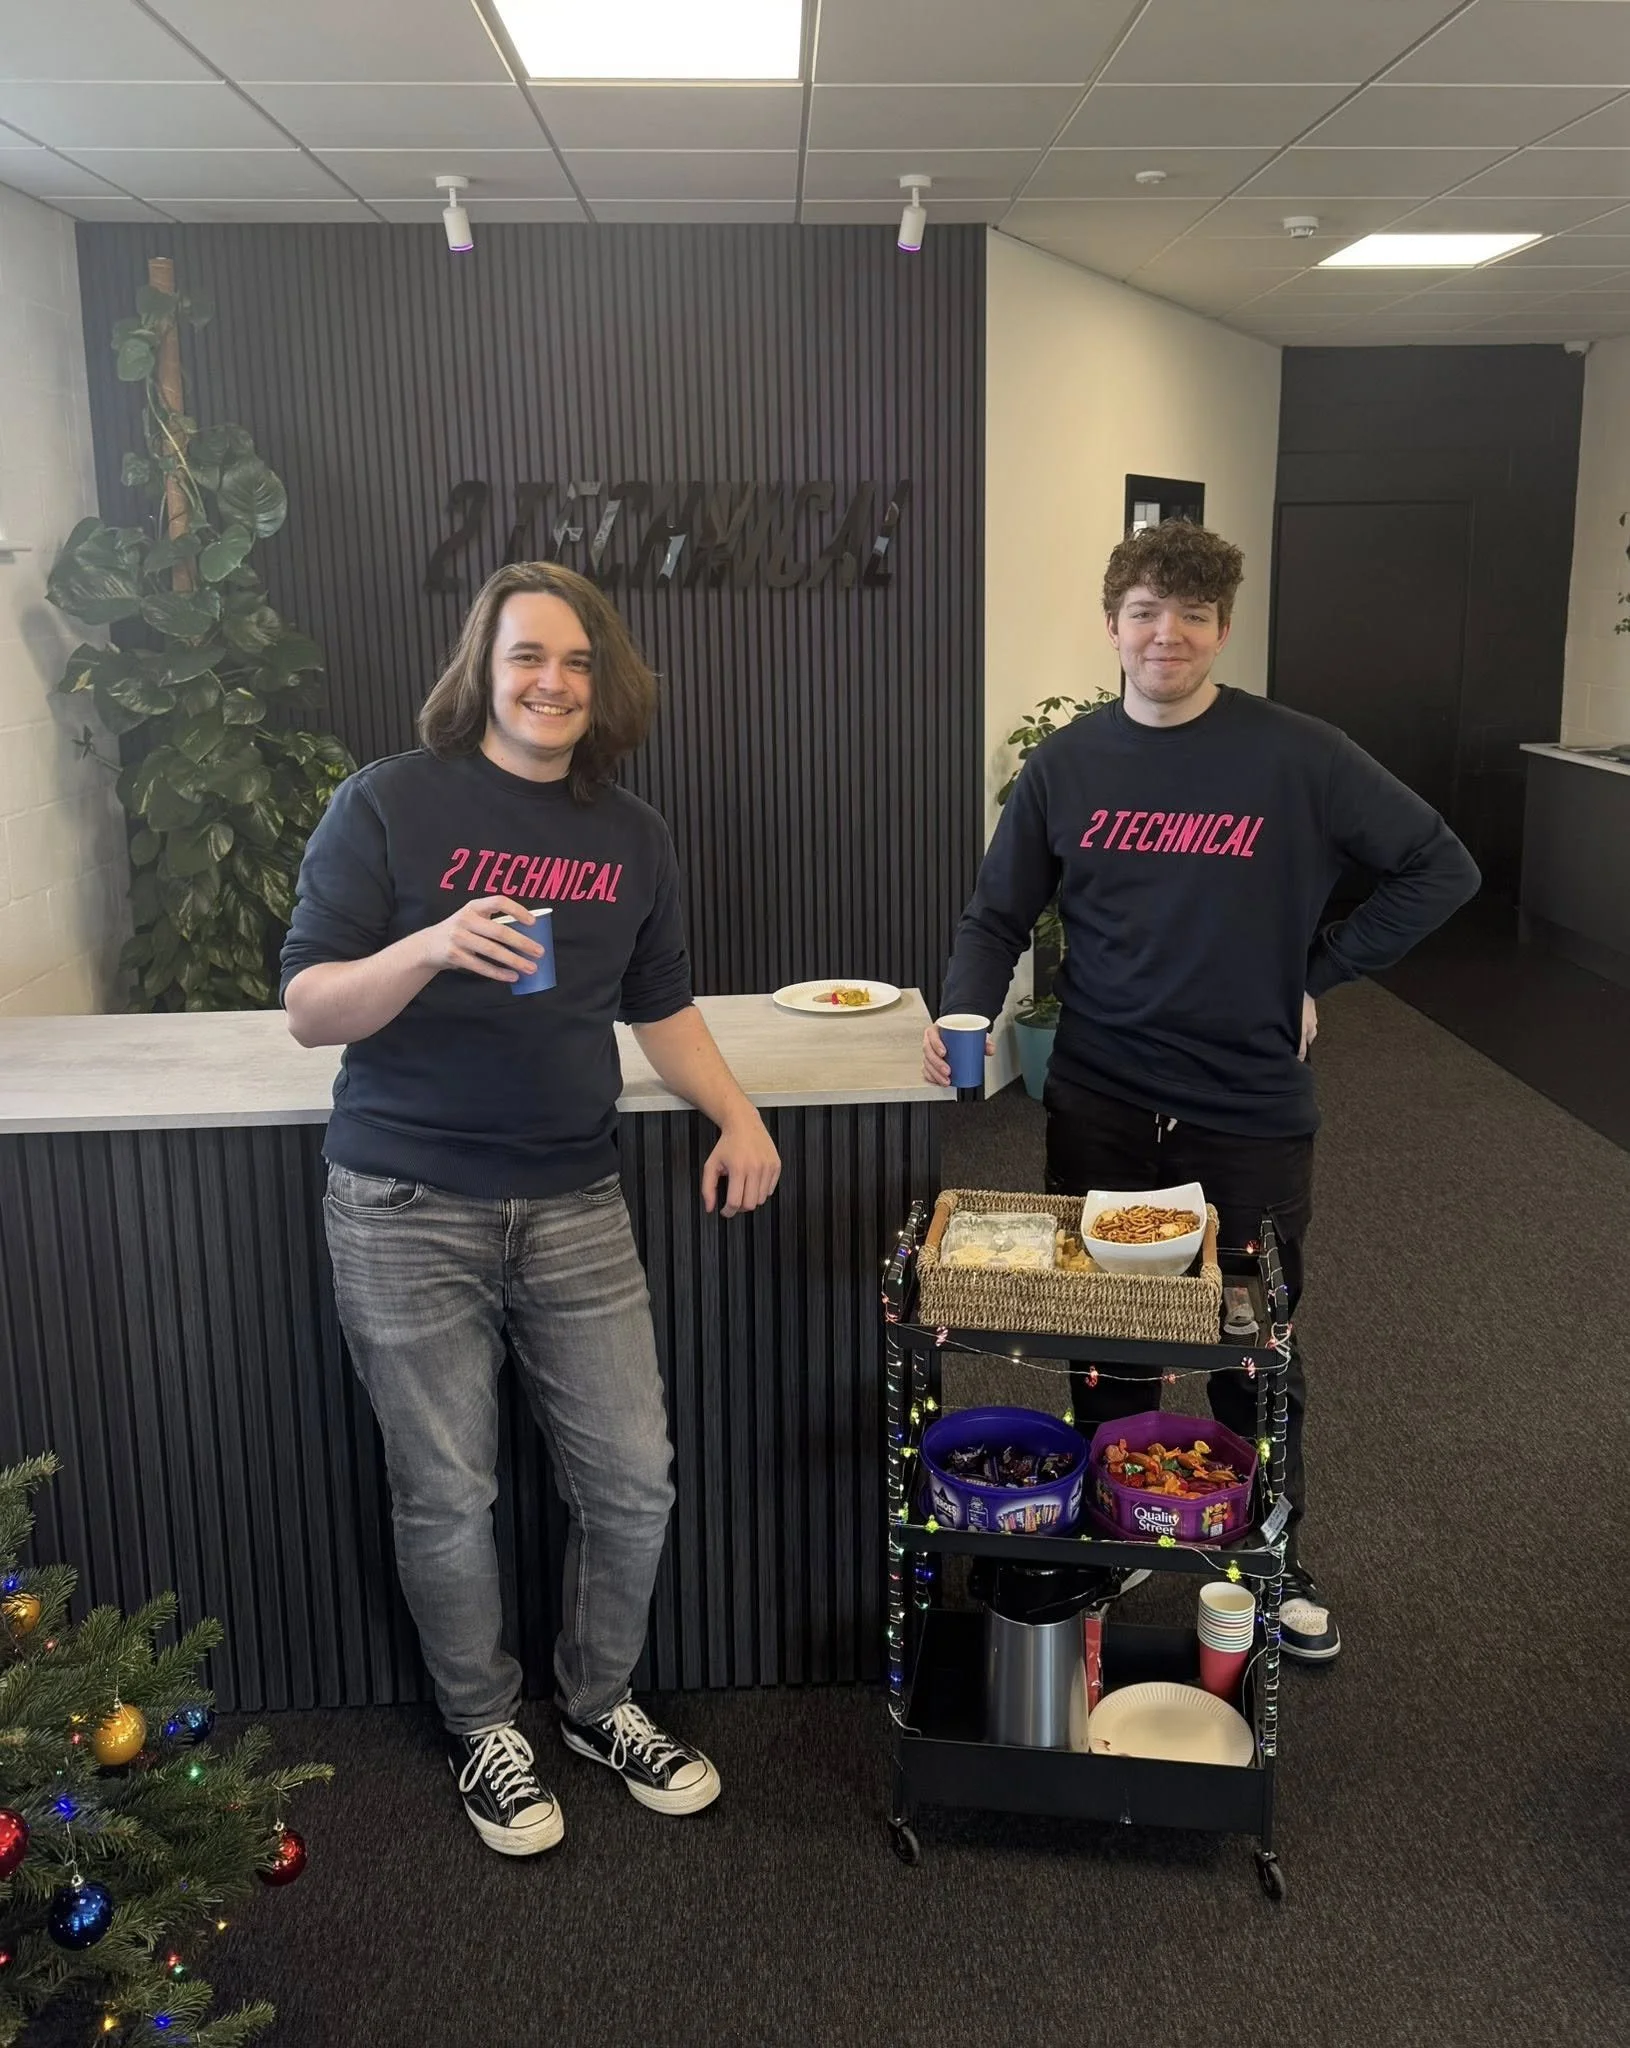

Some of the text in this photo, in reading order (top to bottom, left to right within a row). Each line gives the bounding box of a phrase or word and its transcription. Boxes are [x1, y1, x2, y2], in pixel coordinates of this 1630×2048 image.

[425, 479, 912, 591] 2 TECHNICAL
[1080, 809, 1264, 857] 2 TECHNICAL
[440, 848, 622, 903] 2 TECHNICAL
[1134, 1507, 1180, 1526] Quality
[1138, 1519, 1175, 1536] Street
